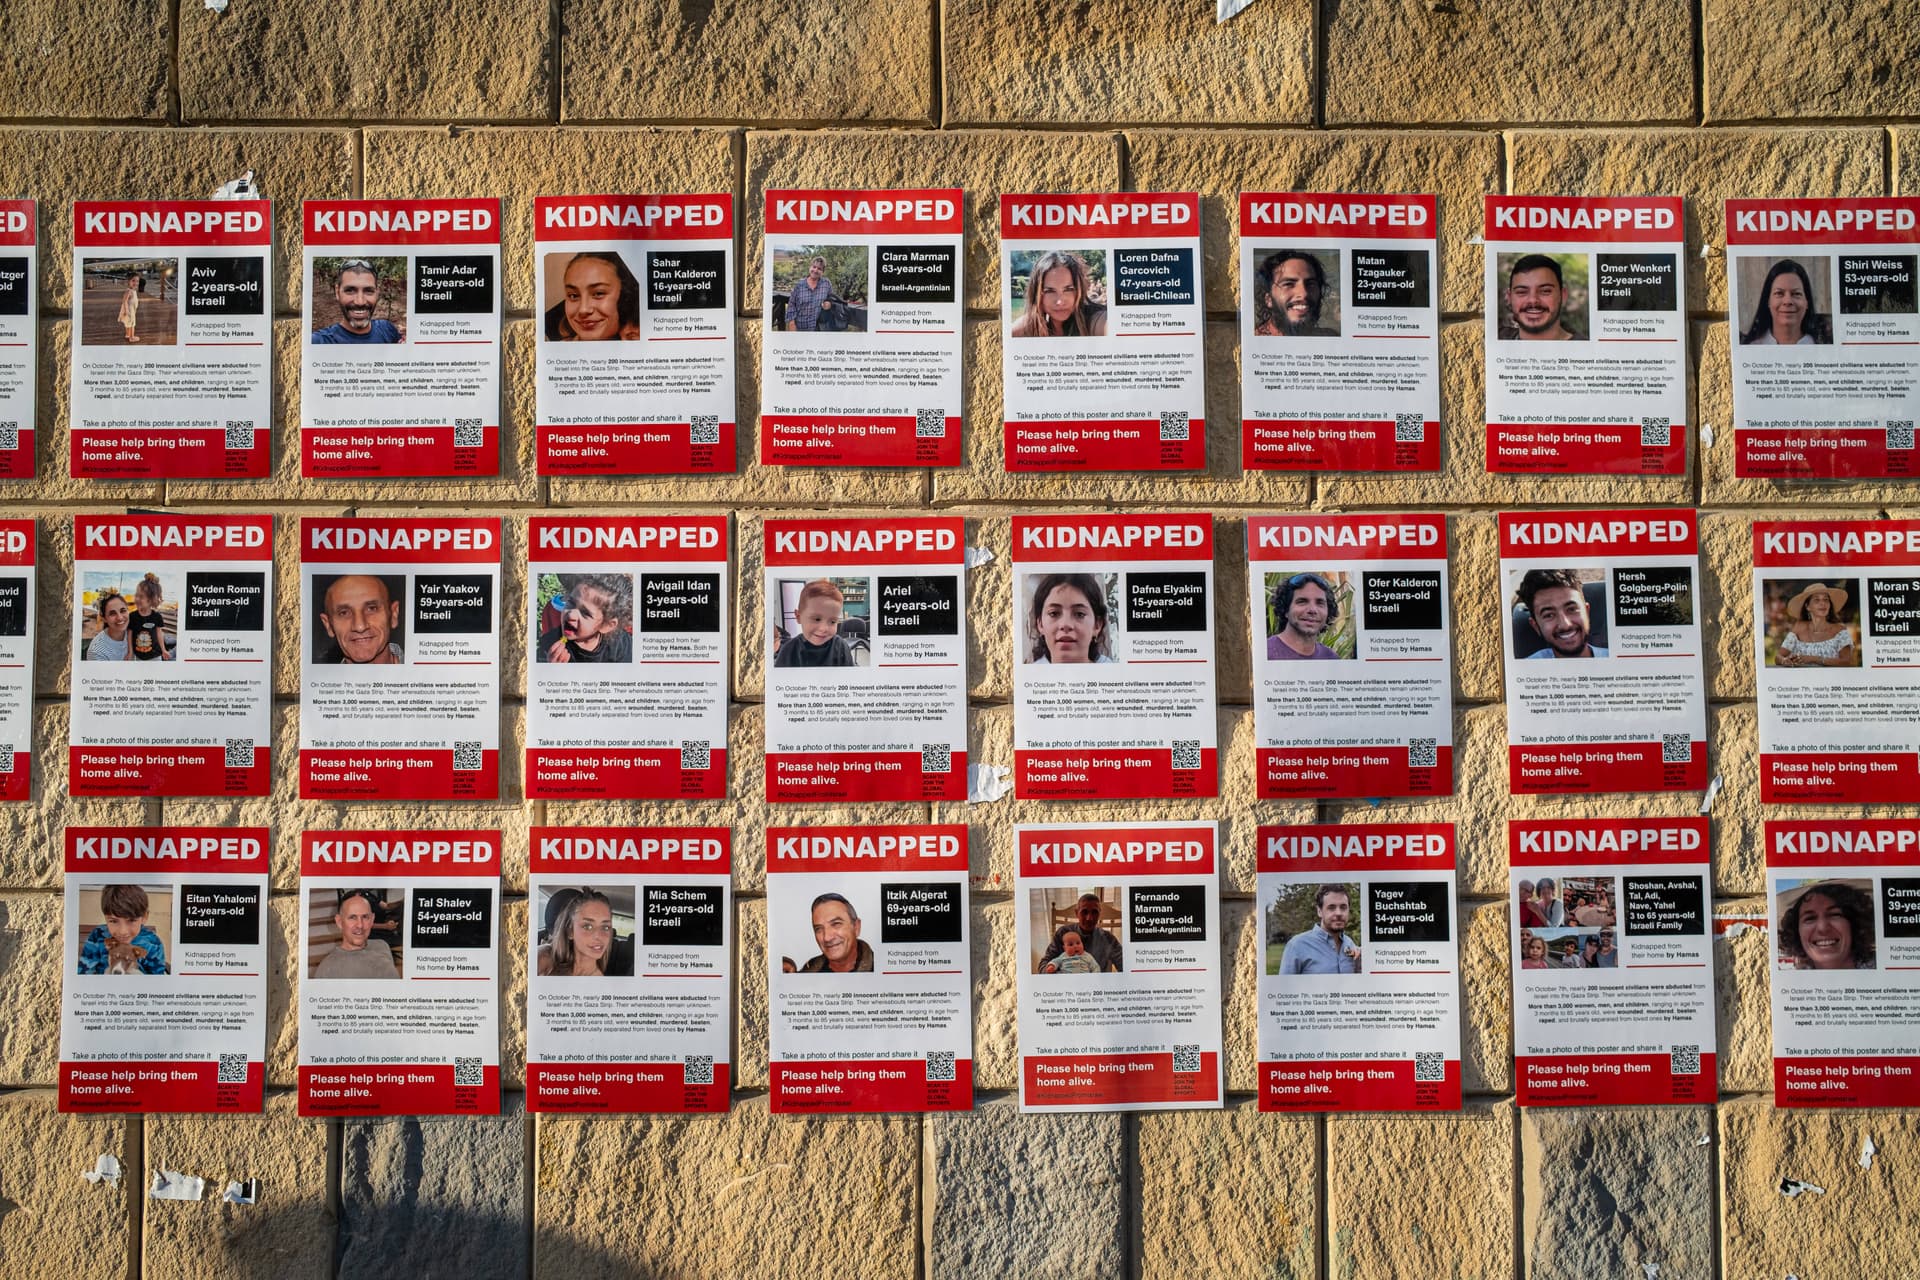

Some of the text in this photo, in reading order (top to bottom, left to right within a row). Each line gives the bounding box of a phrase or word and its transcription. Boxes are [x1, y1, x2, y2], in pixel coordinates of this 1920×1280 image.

[776, 200, 954, 221] KIDNAPPED
[1012, 203, 1190, 225] KIDNAPPED
[1251, 202, 1427, 226] KIDNAPPED
[314, 209, 492, 232] KIDNAPPED
[545, 205, 724, 228] KIDNAPPED
[1496, 207, 1674, 229] KIDNAPPED
[1736, 209, 1915, 232] KIDNAPPED
[85, 211, 263, 233] KIDNAPPED
[882, 252, 949, 261] Clara Marman
[1120, 253, 1179, 262] Loren Dafna
[1357, 256, 1385, 265] Matan
[653, 258, 681, 267] Sahar
[1844, 260, 1903, 270] Shiri Weiss
[192, 267, 216, 277] Aviv
[421, 265, 477, 275] Tamir Adar
[882, 264, 942, 275] 63-years-old
[1120, 266, 1170, 275] Garcovich
[1601, 264, 1671, 272] Omer Wenkert
[0, 271, 25, 281] tzger
[653, 270, 717, 279] Dan Kalderon
[1845, 273, 1909, 285] 53-years-old
[421, 278, 484, 290] 38-years-old
[1120, 278, 1180, 289] 47-years-old
[1357, 279, 1415, 290] 23-years-old
[1601, 276, 1661, 286] 22-years-old
[192, 281, 257, 294] 2-years-old
[654, 281, 711, 292] 16-years-old
[882, 284, 950, 293] Israeli-Argentinian
[1601, 287, 1631, 296] Israeli
[1845, 286, 1876, 296] Israeli
[421, 291, 452, 300] Israeli
[653, 293, 682, 302] Israeli
[1121, 291, 1191, 300] Israeli-Chilean
[1358, 291, 1386, 300] Israeli
[192, 296, 225, 306] Israeli
[82, 437, 205, 449] Please help bring them
[82, 451, 143, 460] home alive.
[86, 525, 264, 547] KIDNAPPED
[540, 527, 719, 548] KIDNAPPED
[1023, 525, 1204, 548] KIDNAPPED
[1259, 525, 1438, 547] KIDNAPPED
[1509, 520, 1688, 545] KIDNAPPED
[312, 528, 492, 550] KIDNAPPED
[775, 529, 955, 552] KIDNAPPED
[1619, 572, 1646, 581] Hersh
[646, 580, 711, 592] Avigail Idan
[1368, 578, 1438, 587] Ofer Kalderon
[1874, 581, 1909, 591] Moran
[192, 585, 260, 594] Yarden Roman
[420, 584, 480, 594] Yair Yaakov
[883, 585, 911, 596] Ariel
[1132, 585, 1202, 596] Dafna Elyakim
[192, 596, 249, 607] 36-years-old
[647, 594, 708, 606] 3-years-old
[1369, 591, 1430, 602] 53-years-old
[1620, 594, 1676, 606] 23-years-old
[1874, 595, 1905, 605] Yanai
[420, 597, 483, 609] 59-years-old
[883, 600, 950, 613] 4-years-old
[1132, 597, 1193, 608] 15-years-old
[191, 608, 220, 617] Israeli
[647, 608, 680, 618] Israeli
[1369, 603, 1400, 613] Israeli
[1620, 606, 1648, 615] Israeli
[420, 610, 451, 620] Israeli
[1132, 609, 1162, 619] Israeli
[884, 615, 920, 625] Israeli
[1875, 622, 1909, 632] Israeli
[563, 739, 583, 748] photo
[608, 739, 630, 748] poster
[1520, 828, 1700, 853] KIDNAPPED
[76, 837, 260, 860] KIDNAPPED
[541, 838, 722, 860] KIDNAPPED
[777, 835, 959, 859] KIDNAPPED
[1268, 834, 1446, 858] KIDNAPPED
[312, 841, 492, 863] KIDNAPPED
[1031, 841, 1203, 864] KIDNAPPED
[186, 894, 256, 903] Eitan Yahalomi
[649, 890, 707, 900] Mia Schem
[887, 890, 908, 900] Itzik
[1135, 892, 1180, 901] Fernando
[1375, 890, 1404, 900] Yagev
[1629, 892, 1661, 900] Tal, Adi,
[418, 898, 472, 907] Tal Shalev
[1629, 901, 1675, 910] Nave, Yahel
[186, 906, 244, 917] 12-years-old
[649, 904, 714, 915] 21-years-old
[887, 903, 950, 915] 69-years-old
[1135, 905, 1173, 913] Marman
[417, 911, 482, 923] 54-years-old
[887, 916, 918, 926] Israeli
[1135, 915, 1193, 926] 60-years-old
[1375, 913, 1434, 924] 34-years-old
[1630, 912, 1635, 920] 3
[1658, 911, 1695, 921] years-old
[186, 918, 215, 927] Israeli
[649, 917, 681, 926] Israeli
[1630, 921, 1683, 931] Israeli Family
[417, 924, 449, 934] Israeli
[1135, 926, 1202, 934] Israeli-Argentinian
[1375, 925, 1404, 934] Israeli
[1405, 958, 1415, 966] by
